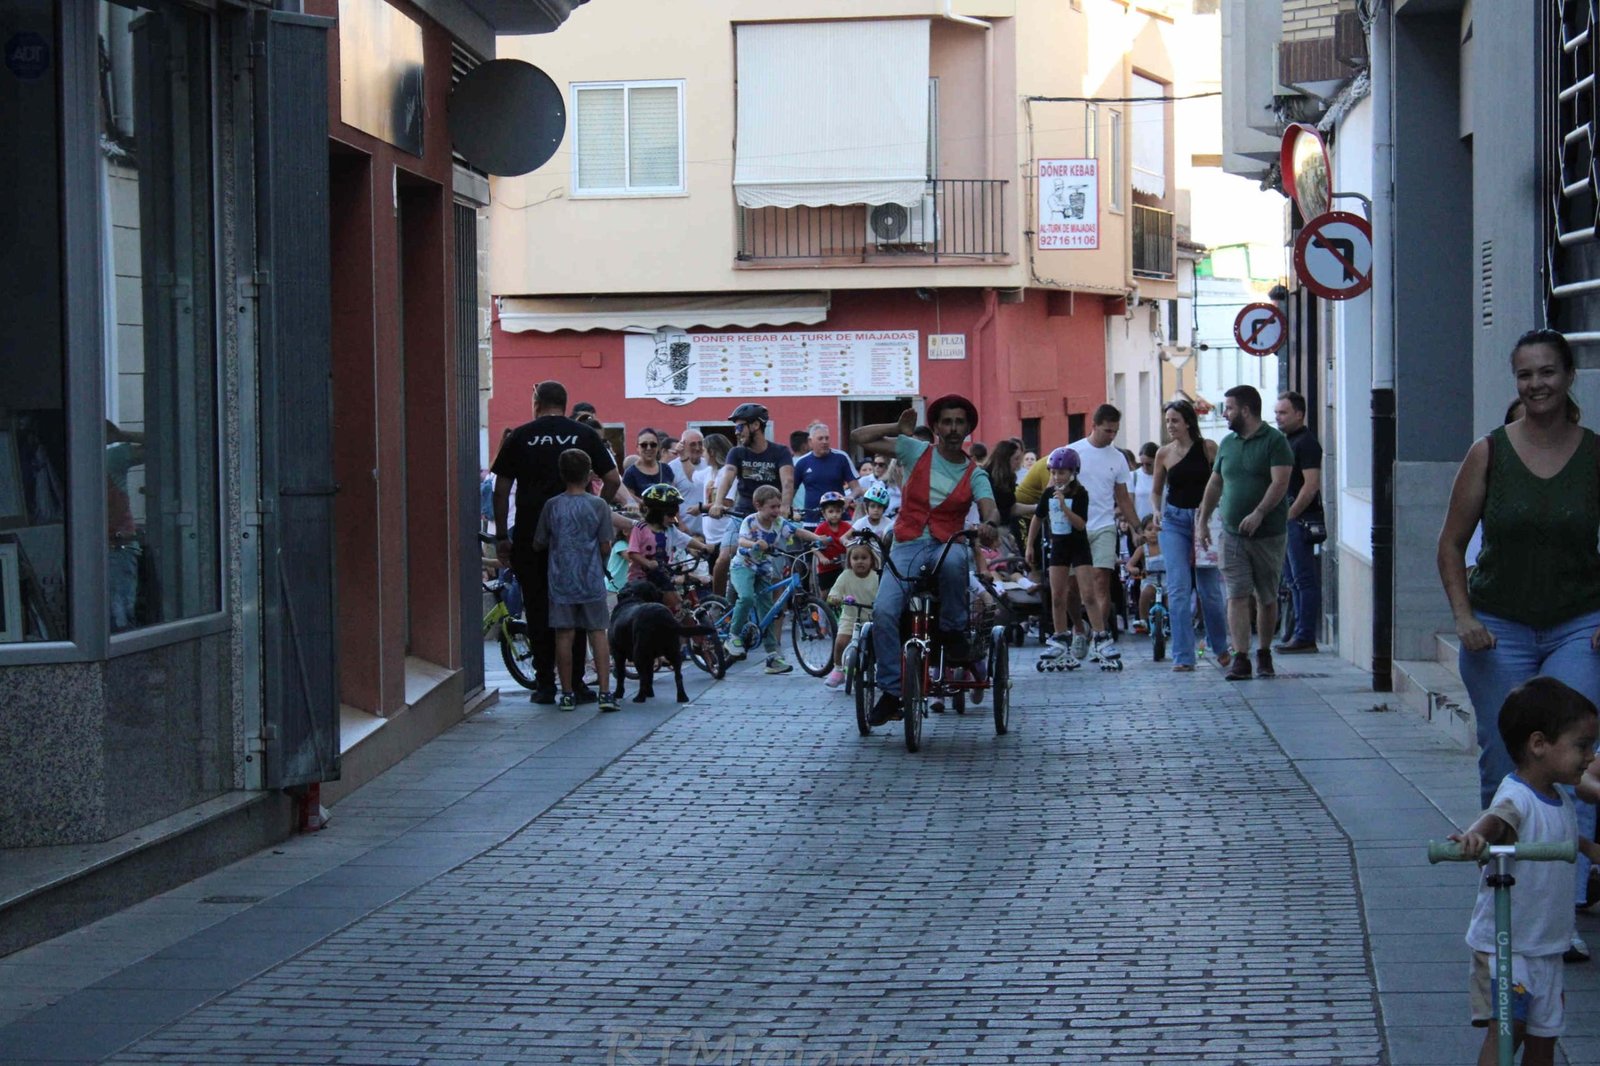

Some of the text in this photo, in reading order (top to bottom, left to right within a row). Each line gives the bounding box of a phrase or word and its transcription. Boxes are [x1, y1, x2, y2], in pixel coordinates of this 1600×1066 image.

[1069, 164, 1095, 177] KEBAB
[1062, 223, 1070, 233] DE
[737, 334, 778, 342] KEBAB
[780, 333, 833, 342] AL-TURK
[836, 333, 853, 341] DE
[855, 332, 916, 341] MIAJADAS
[941, 336, 964, 345] PLAZA
[527, 434, 579, 446] JAVI
